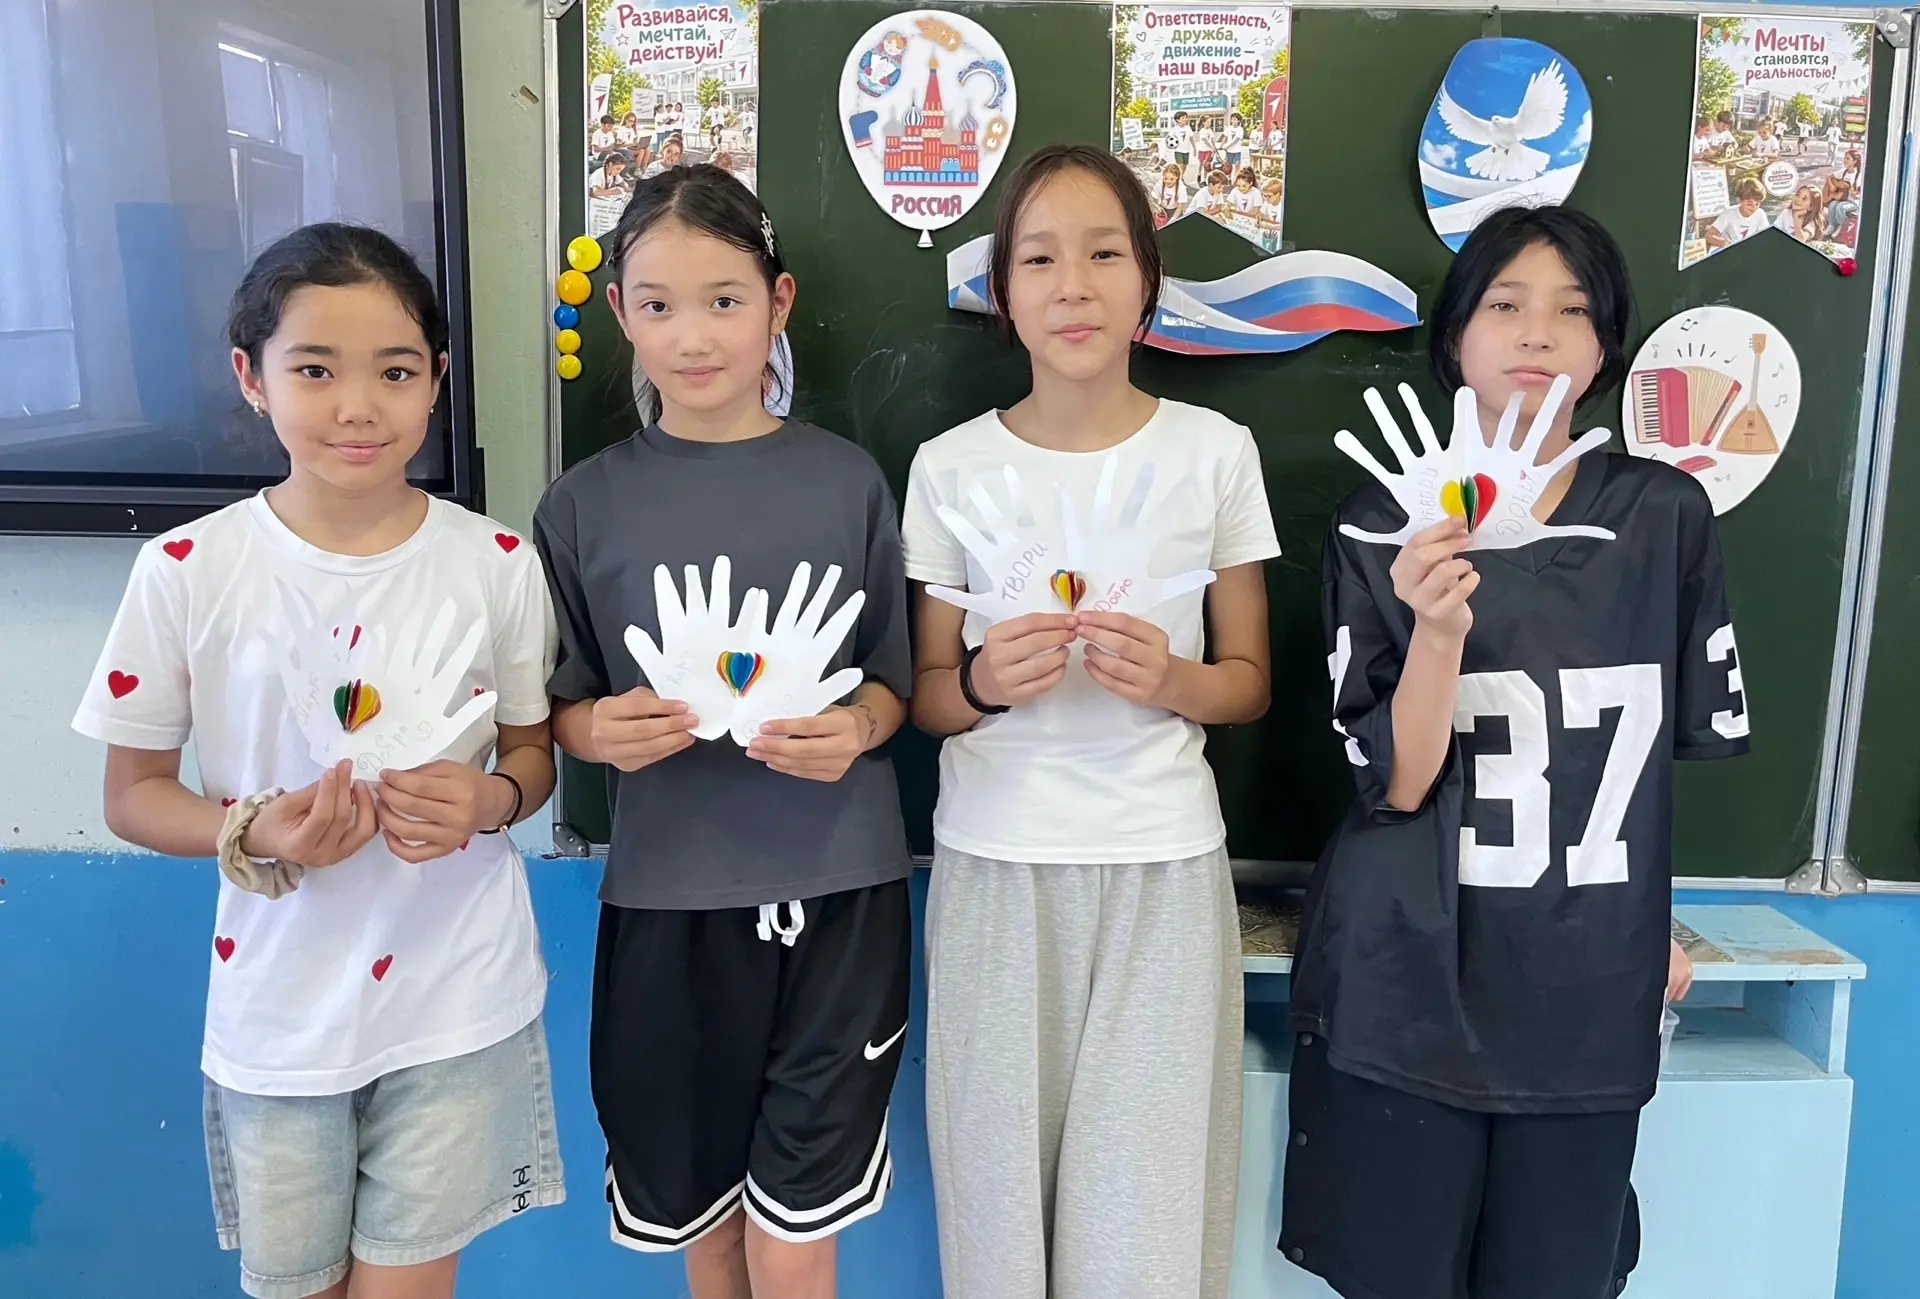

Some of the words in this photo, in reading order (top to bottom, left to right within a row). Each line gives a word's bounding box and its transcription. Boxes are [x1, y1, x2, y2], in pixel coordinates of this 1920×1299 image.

[616, 4, 733, 29] Развивайся,
[1145, 11, 1271, 31] Ответственность,
[638, 25, 711, 44] мечтай,
[1171, 27, 1238, 44] дружба,
[1754, 28, 1825, 52] Мечты
[629, 39, 724, 65] действуй!
[1162, 44, 1241, 60] движение
[1753, 54, 1829, 66] становятся
[1158, 61, 1195, 77] наш
[1201, 60, 1259, 80] выбор!
[1745, 66, 1837, 86] реальностью!
[891, 193, 963, 218] РОССИЯ
[1454, 663, 1662, 888] 37
